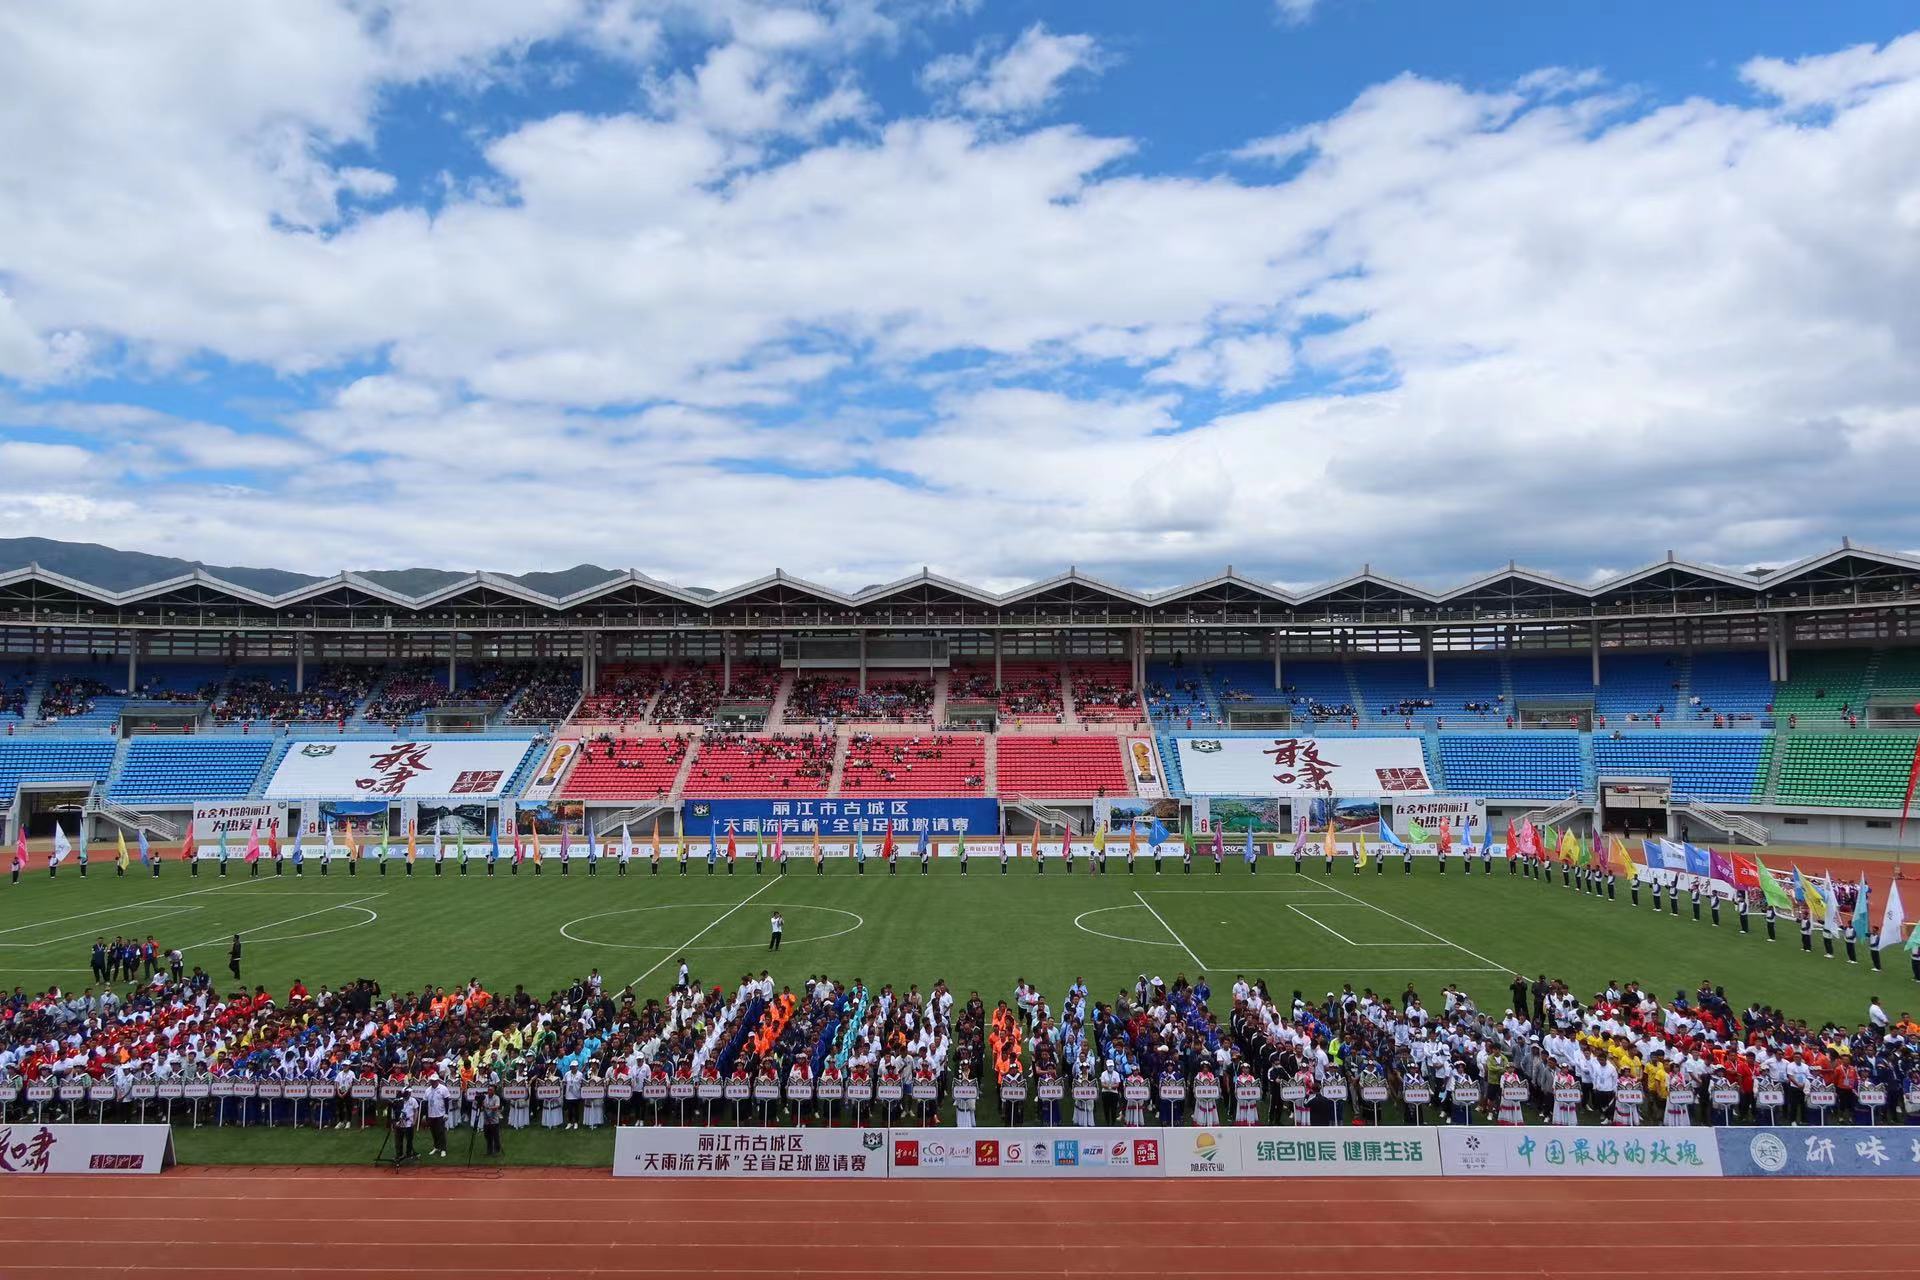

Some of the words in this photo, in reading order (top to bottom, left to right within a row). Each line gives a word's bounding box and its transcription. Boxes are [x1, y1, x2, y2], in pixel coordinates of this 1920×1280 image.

[196, 805, 272, 819] 在舍不得的丽江
[772, 801, 909, 815] 丽江市古城区
[1396, 802, 1469, 814] 在舍不得的丽江
[698, 1133, 805, 1151] 丽江市古城区
[1256, 1140, 1337, 1162] 绿色旭辰
[1342, 1140, 1423, 1162] 健康生活
[1517, 1135, 1704, 1168] 中国最好的玫瑰
[634, 1153, 867, 1172] “天雨流芳杯”全省足球邀请赛
